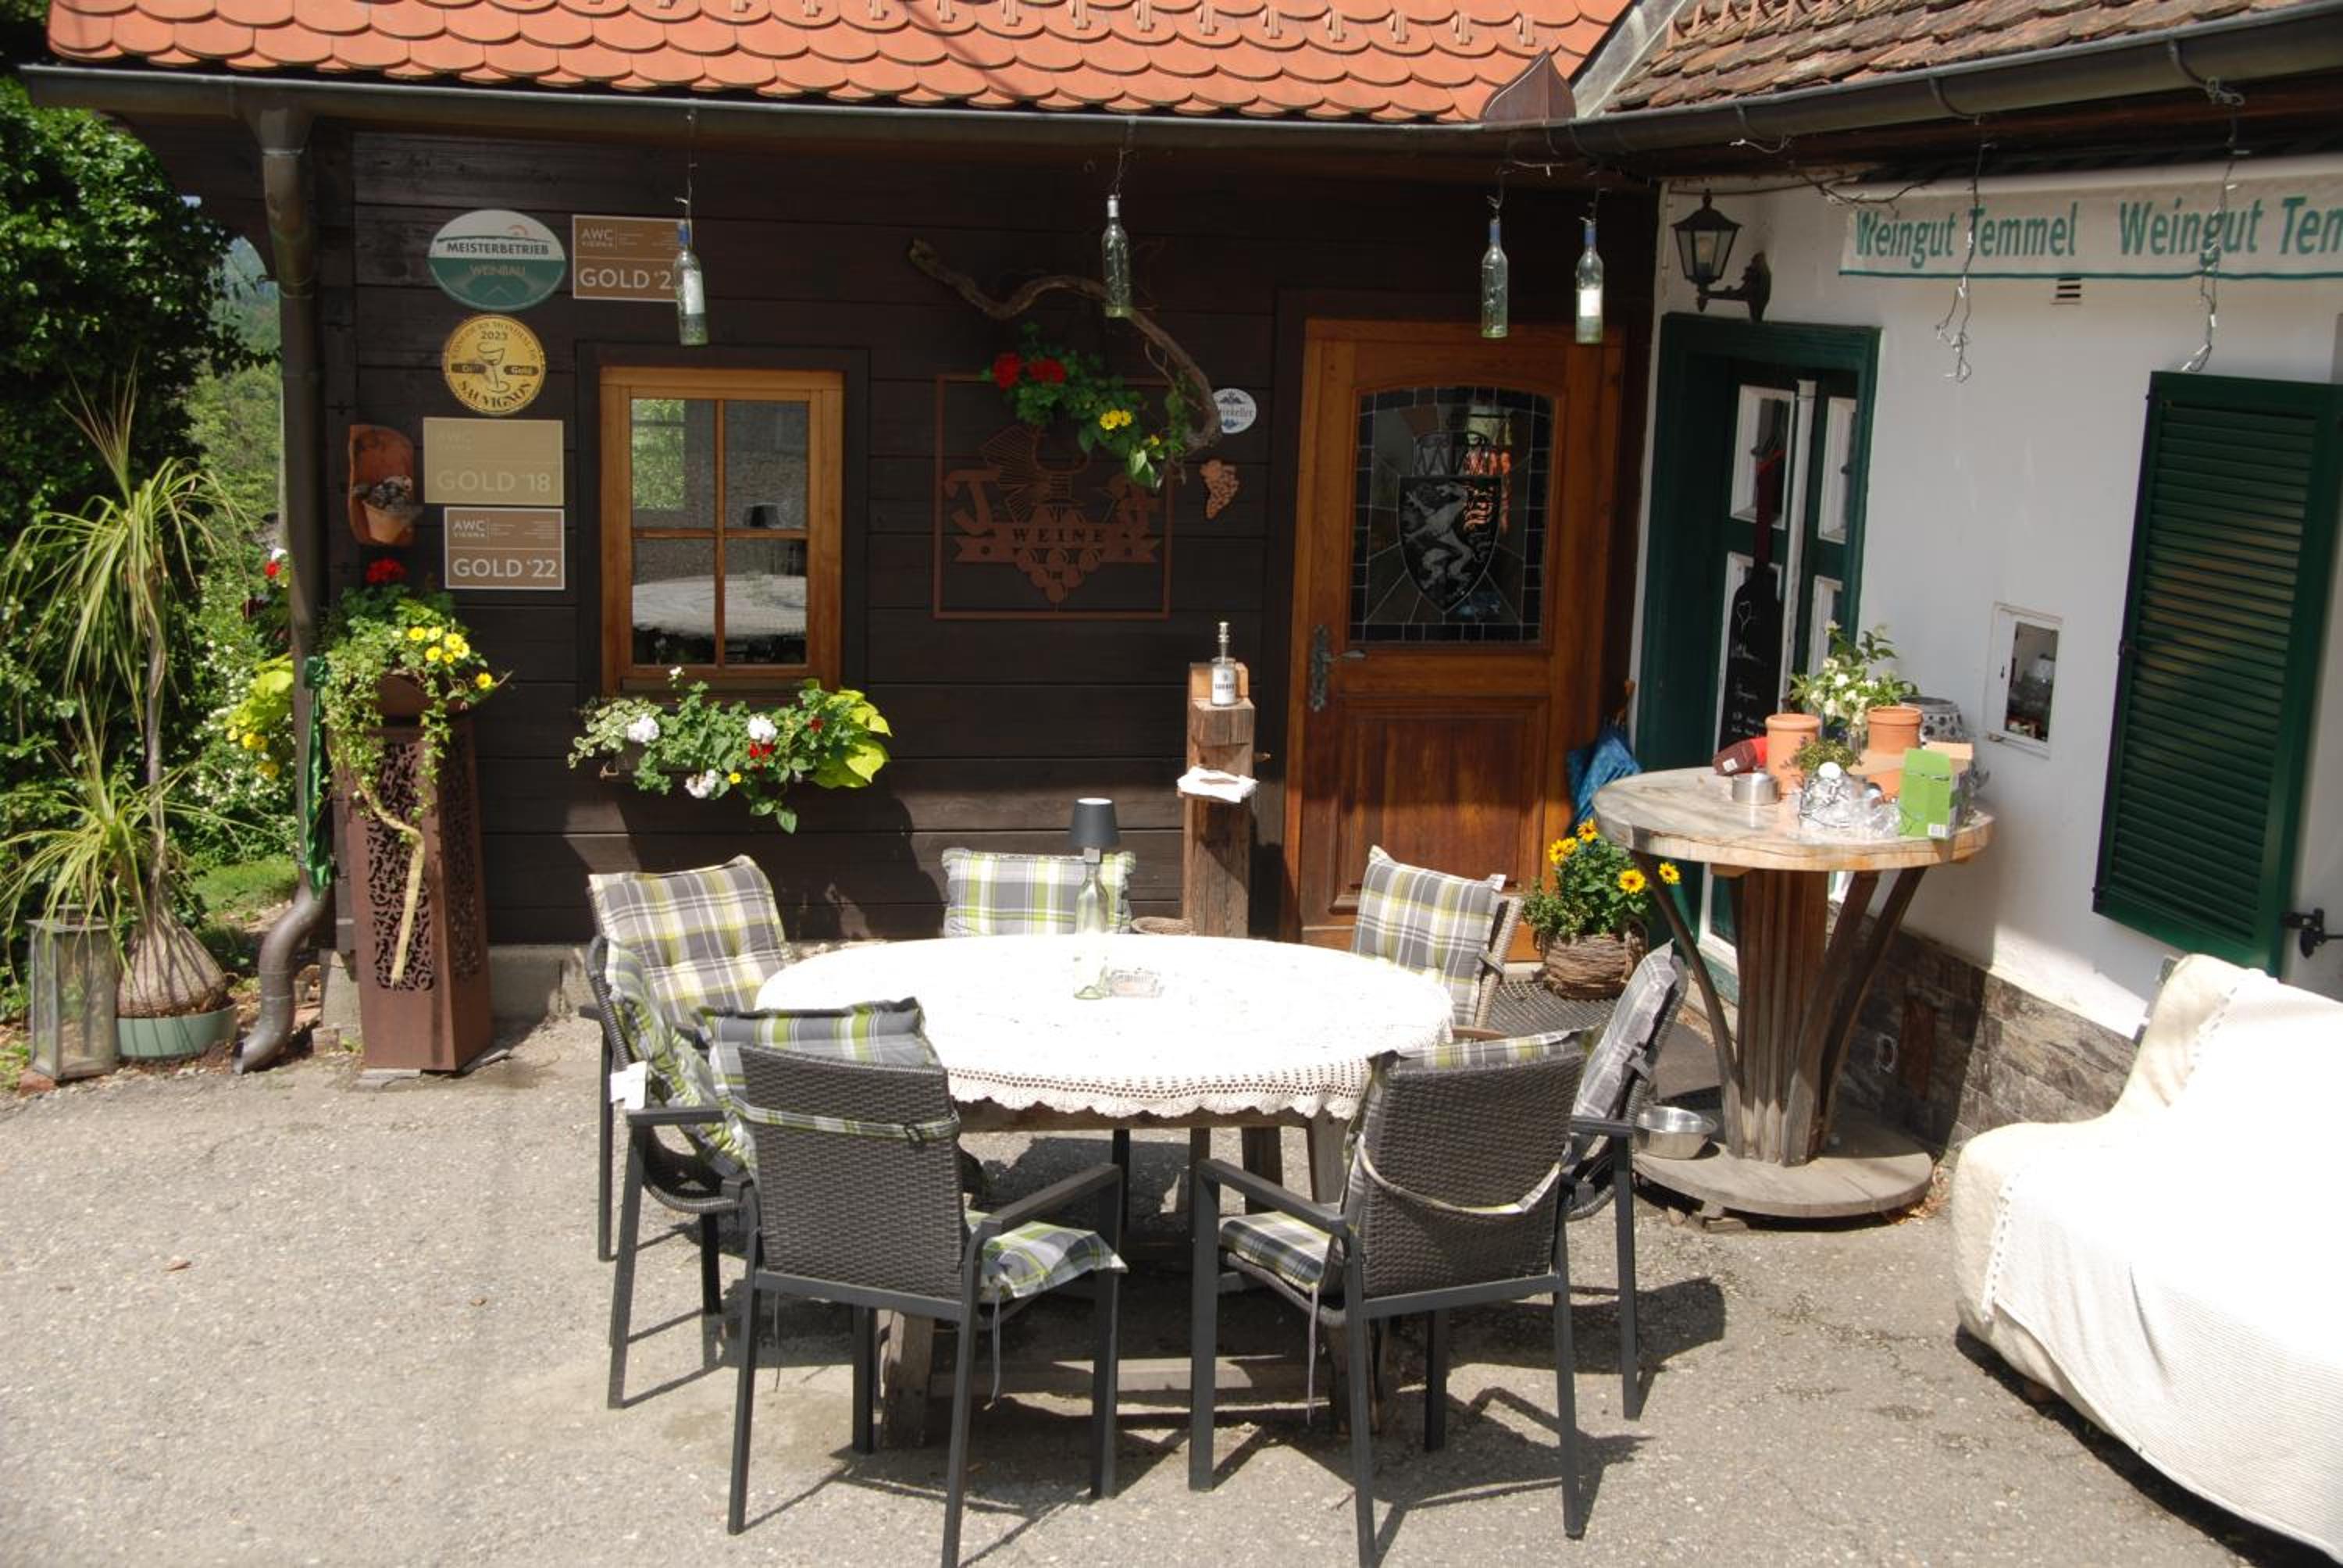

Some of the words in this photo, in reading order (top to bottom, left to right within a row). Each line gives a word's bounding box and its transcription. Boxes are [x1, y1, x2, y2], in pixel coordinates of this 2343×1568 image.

[581, 228, 614, 241] AWC
[1856, 211, 1956, 269] Weingut
[1968, 201, 2077, 257] Temmel
[2120, 198, 2263, 269] Weingut
[447, 242, 549, 255] MEISTERBETRIEB
[469, 264, 525, 276] WEINBAU
[579, 268, 650, 289] GOLD
[437, 470, 515, 492] GOLD
[453, 520, 486, 532] AWC
[1012, 528, 1105, 543] WEINE
[452, 558, 522, 577] GOLD
